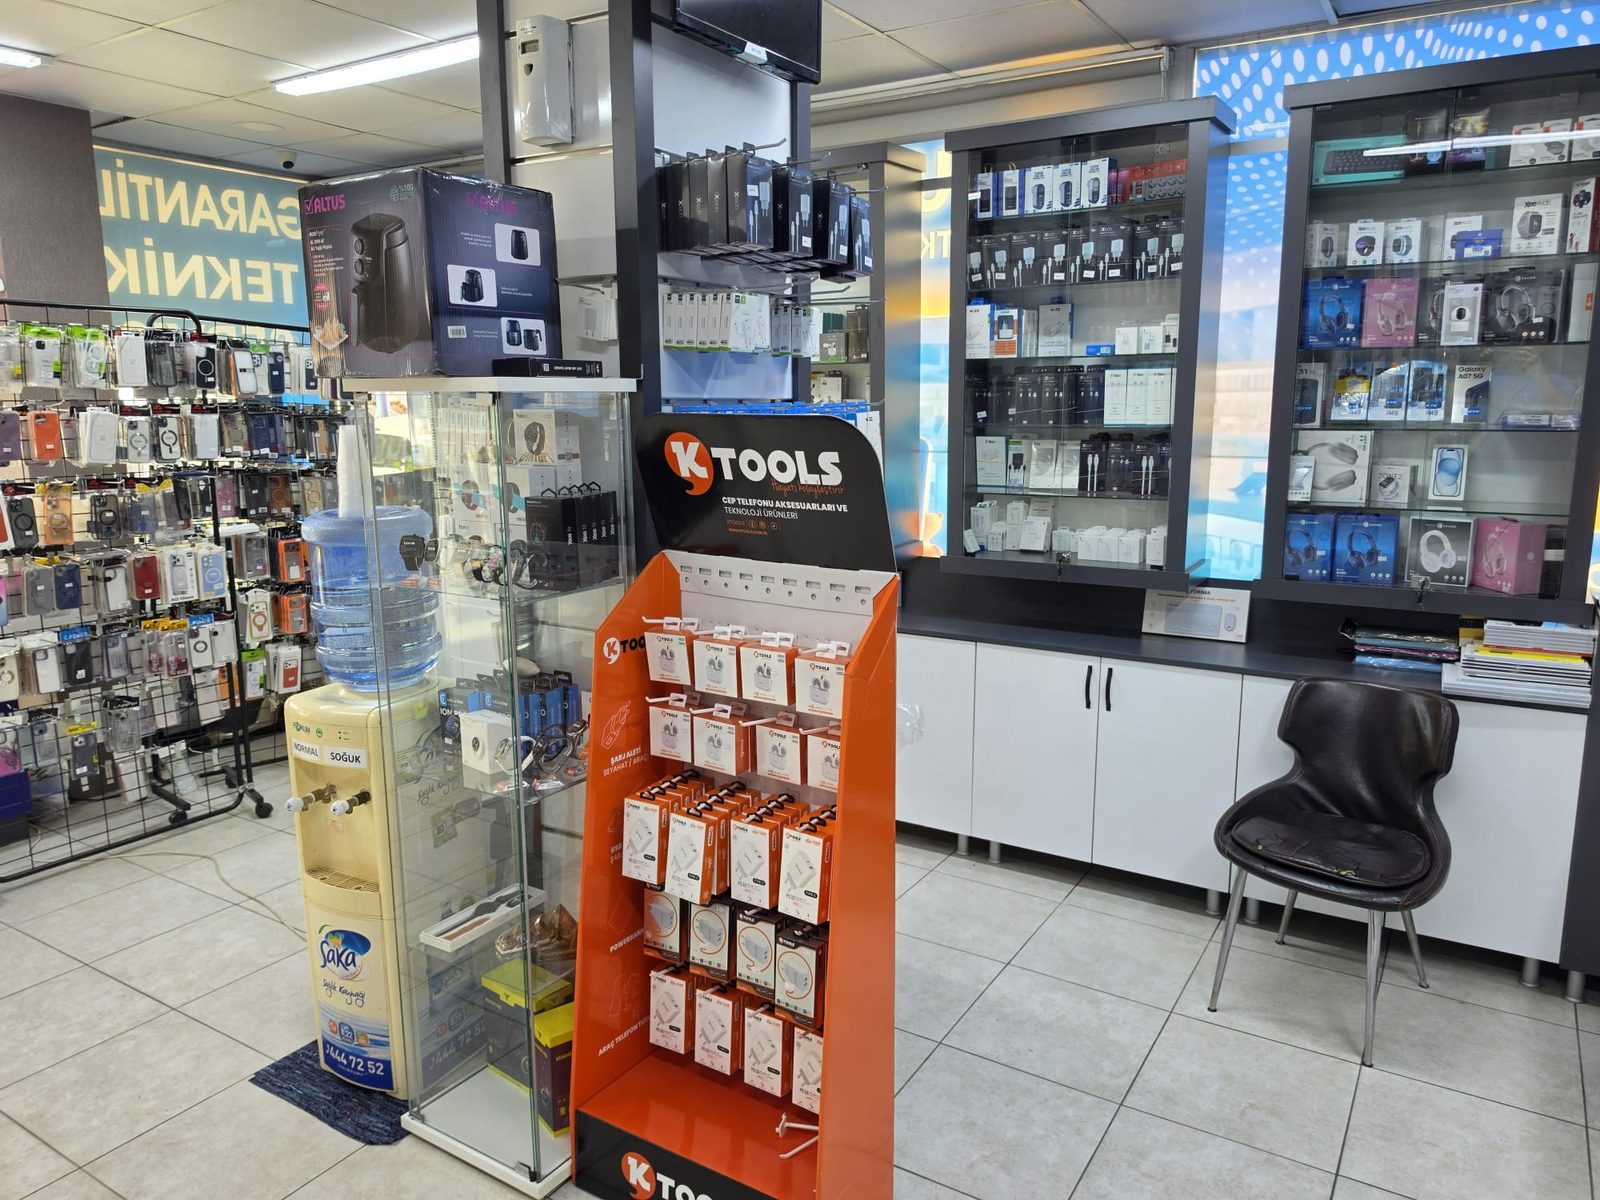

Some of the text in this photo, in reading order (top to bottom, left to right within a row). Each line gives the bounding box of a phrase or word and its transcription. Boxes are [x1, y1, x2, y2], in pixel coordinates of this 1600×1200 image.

[314, 194, 346, 213] ALTUS
[710, 447, 843, 486] TOOLS
[722, 496, 848, 512] CEP TELEFONU AKSESUARLARI VE
[724, 506, 798, 519] TEKNOLOJİ ÜRÜNLERİ
[293, 742, 319, 757] NORMAL
[330, 750, 361, 764] SOĞUK
[610, 745, 641, 766] ŞARJ ALETİ
[603, 760, 628, 776] SEYAHAT
[598, 1039, 615, 1056] ARAÇ
[614, 1024, 638, 1044] TELEFON
[329, 1049, 348, 1065] 444
[349, 1055, 365, 1072] 72
[367, 1061, 384, 1075] 52
[656, 1172, 712, 1200] TO
